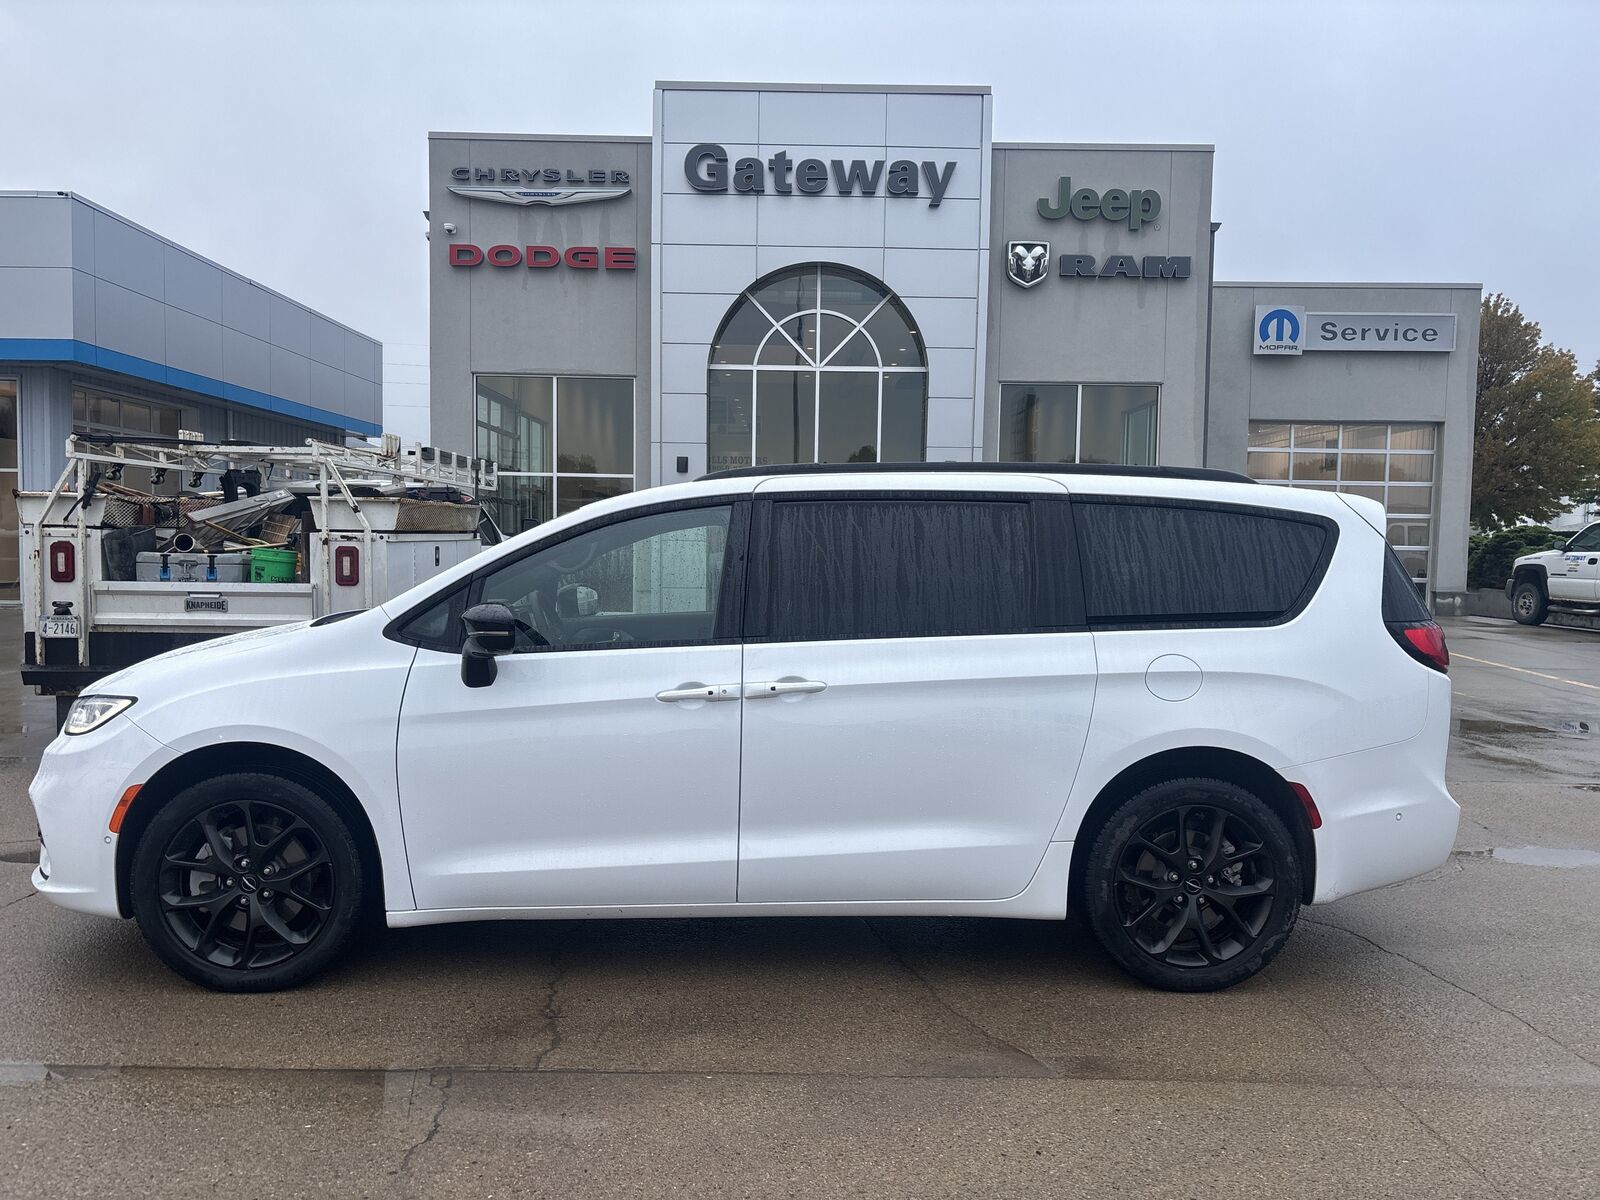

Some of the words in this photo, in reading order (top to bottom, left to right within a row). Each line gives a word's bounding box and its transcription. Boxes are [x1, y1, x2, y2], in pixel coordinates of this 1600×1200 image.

[451, 167, 630, 183] CHRYSLER
[684, 143, 958, 208] Gateway
[1037, 176, 1161, 231] Jeep
[449, 244, 636, 270] DODGE
[1059, 254, 1192, 279] RAM
[1320, 321, 1439, 342] Service
[186, 600, 226, 610] KNAPHEIDE
